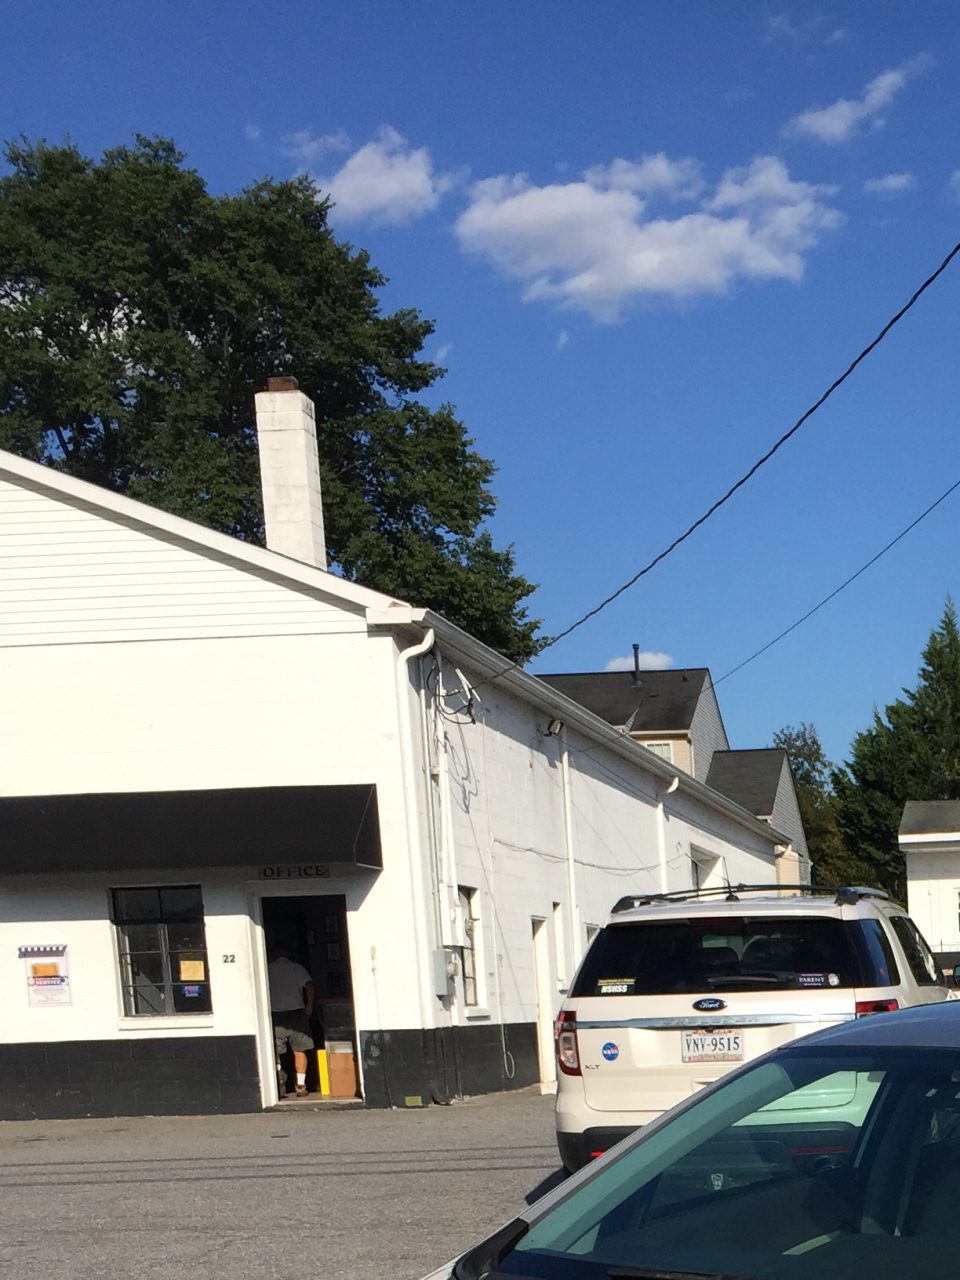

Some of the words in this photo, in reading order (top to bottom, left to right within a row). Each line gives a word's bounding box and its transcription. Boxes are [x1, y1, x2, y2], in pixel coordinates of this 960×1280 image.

[263, 865, 326, 878] OFFICE
[222, 954, 236, 964] 22
[685, 1036, 740, 1053] VNV-9515
